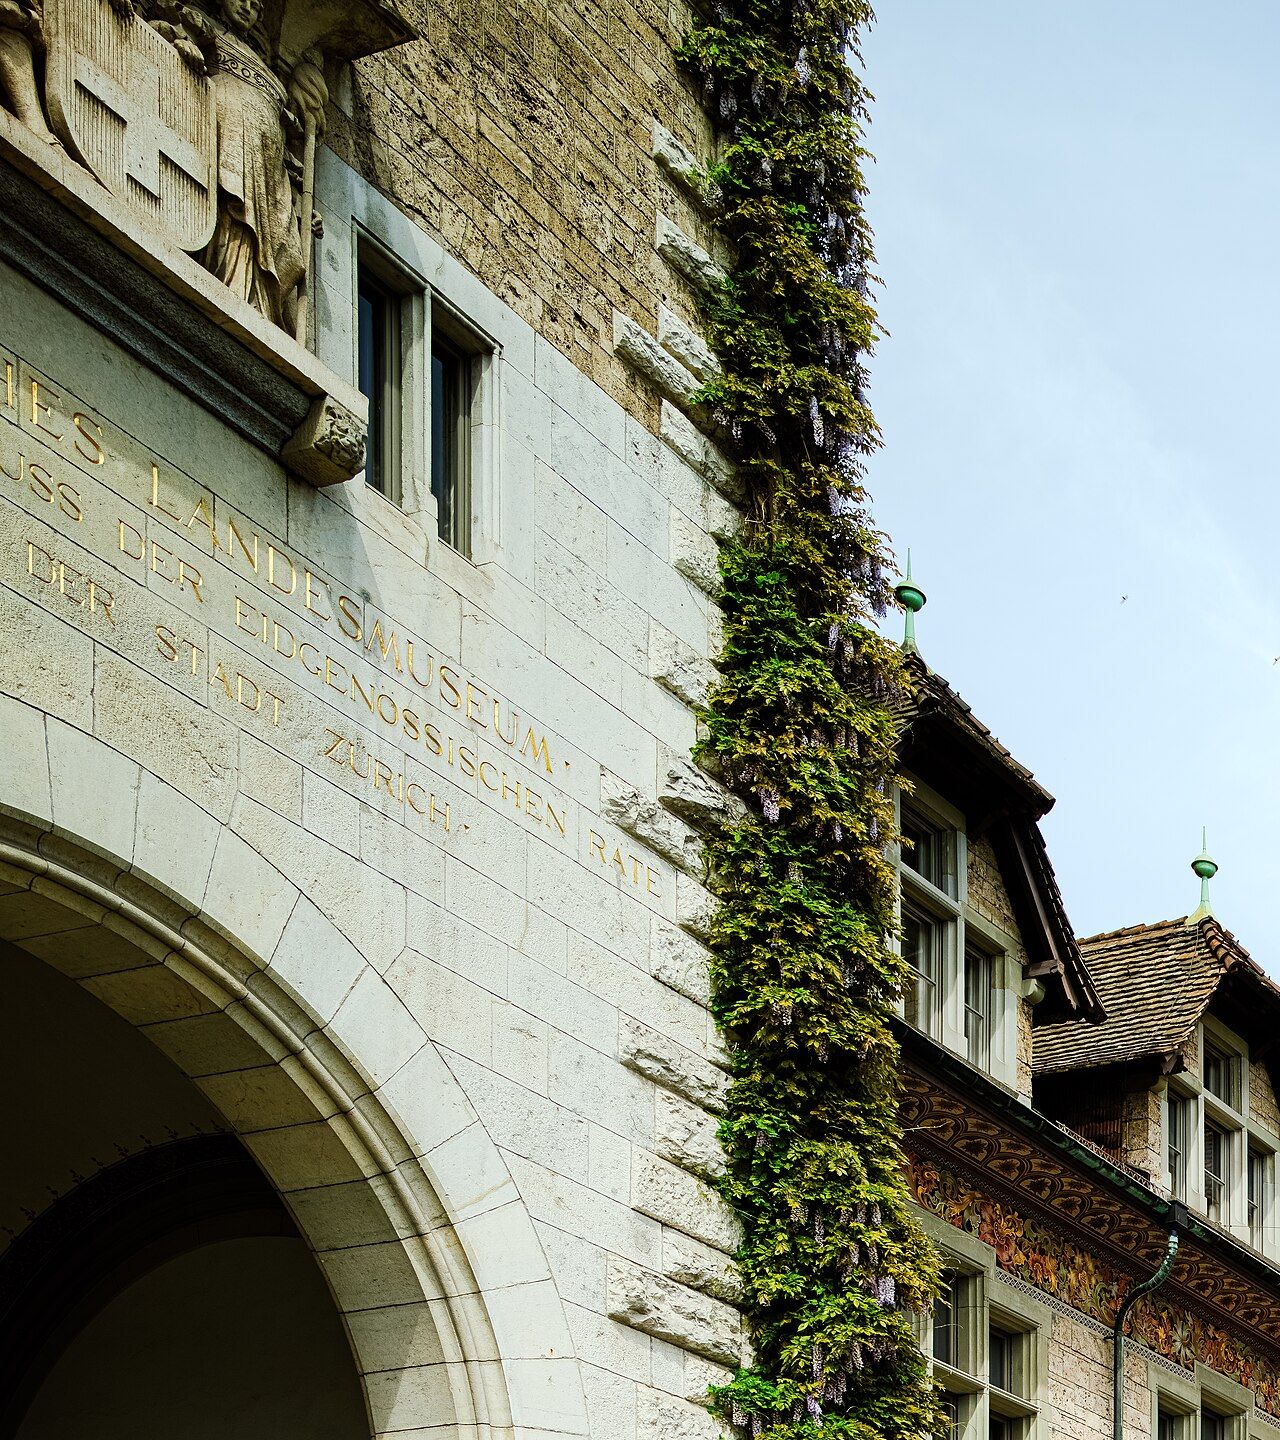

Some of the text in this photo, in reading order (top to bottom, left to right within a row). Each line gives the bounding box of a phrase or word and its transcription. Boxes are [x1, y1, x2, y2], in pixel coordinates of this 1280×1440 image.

[27, 540, 116, 629] DER
[155, 625, 286, 726] STADT
[118, 518, 204, 603] DER
[235, 595, 567, 838] EIDGENÖSSISCHEN
